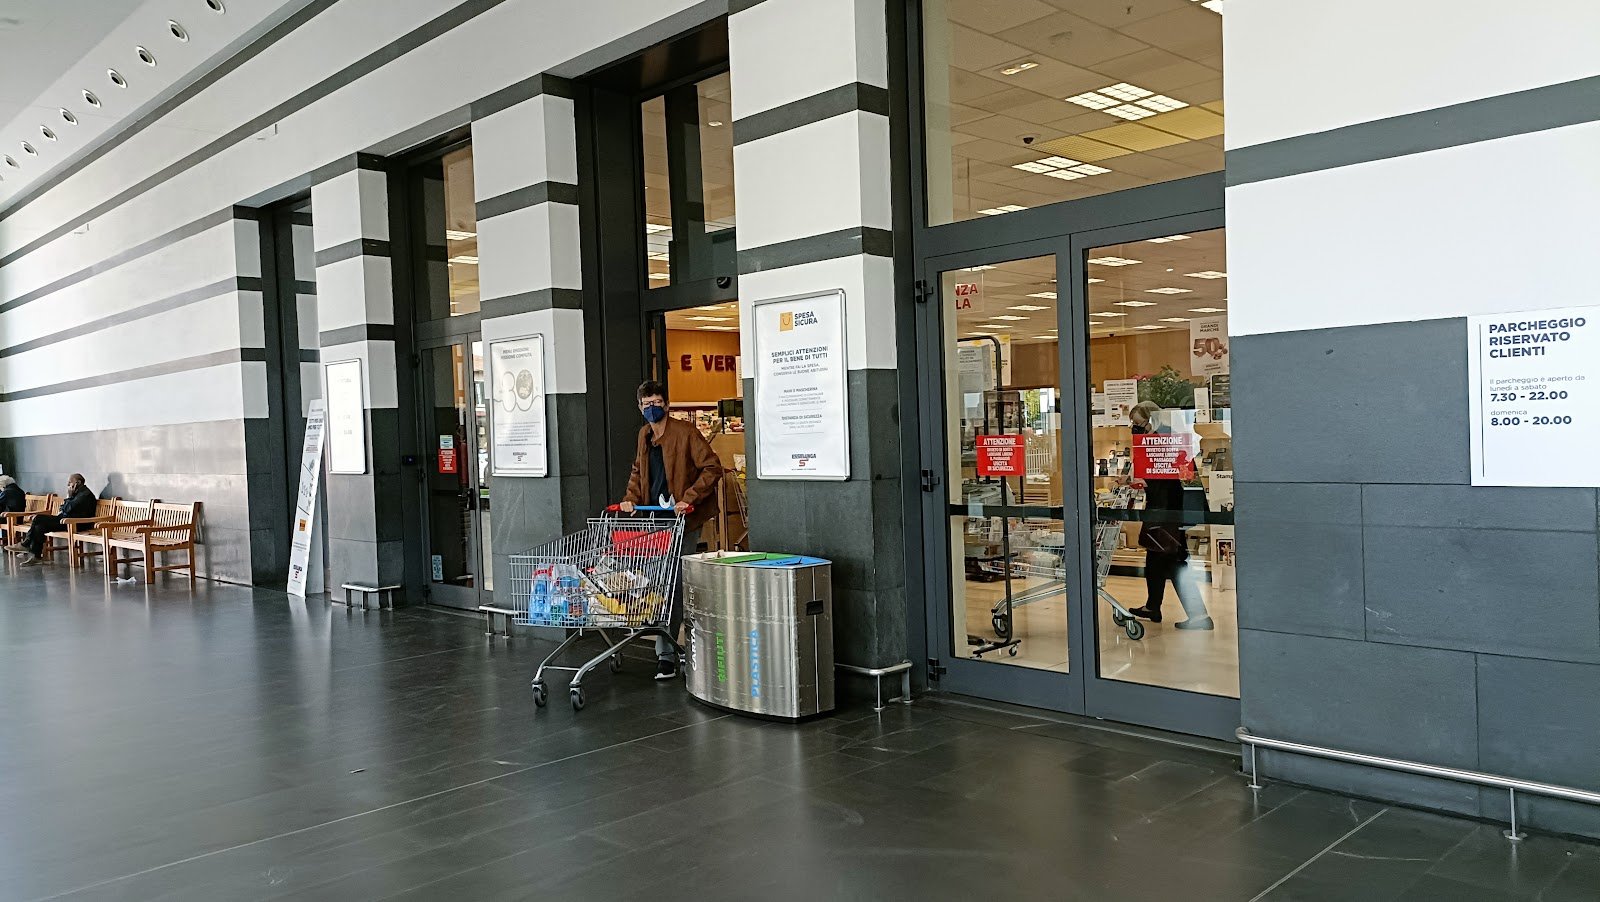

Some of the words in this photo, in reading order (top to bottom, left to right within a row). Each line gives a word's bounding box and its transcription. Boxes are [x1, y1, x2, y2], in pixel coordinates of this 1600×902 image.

[794, 311, 814, 319] SPESA
[794, 318, 818, 326] SICURA
[1489, 318, 1586, 334] PARCHEGGIO
[1489, 332, 1570, 346] RISERVATO
[796, 346, 828, 354] ATTENZIONI
[1490, 346, 1545, 358] CLIENTI
[681, 354, 692, 371] E
[1490, 393, 1517, 402] 7.30
[1529, 390, 1568, 400] 22.00
[1491, 417, 1520, 426] 8.00
[1532, 416, 1572, 424] 20.00
[983, 438, 1016, 446] ATTENZIONE
[1142, 437, 1182, 445] ATTENZIONE
[716, 632, 727, 683] RIFIUTI
[748, 629, 760, 698] PLASTICA
